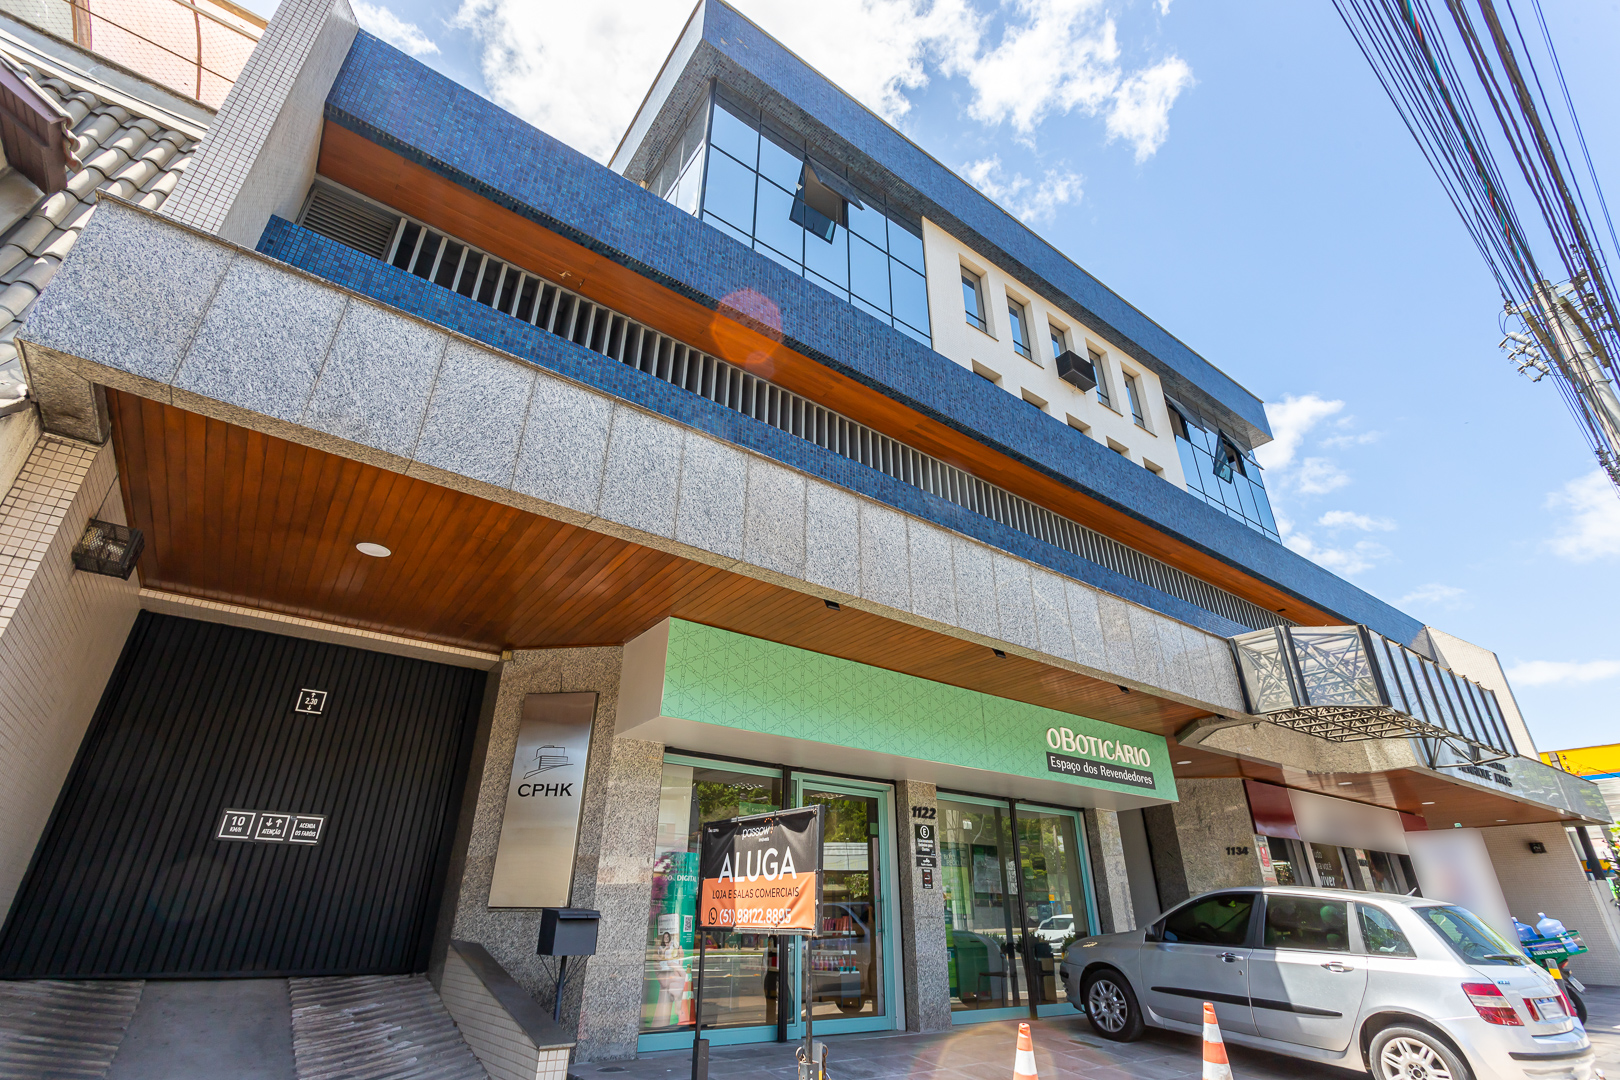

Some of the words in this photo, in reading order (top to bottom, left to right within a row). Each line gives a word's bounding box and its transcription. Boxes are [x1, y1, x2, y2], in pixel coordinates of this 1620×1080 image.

[1050, 756, 1081, 774] Espaço
[1083, 762, 1098, 775] dos
[1100, 765, 1153, 785] Revendedores
[517, 783, 573, 797] CPHK
[912, 806, 937, 819] 1122
[231, 816, 246, 826] 10
[262, 828, 281, 836] ATENÇÃO
[1225, 846, 1249, 856] 1134
[718, 846, 797, 883] ALUGA
[712, 889, 727, 899] LOJA
[728, 889, 733, 899] E
[733, 888, 754, 899] SALAS
[755, 887, 800, 898] COMERCIAIS
